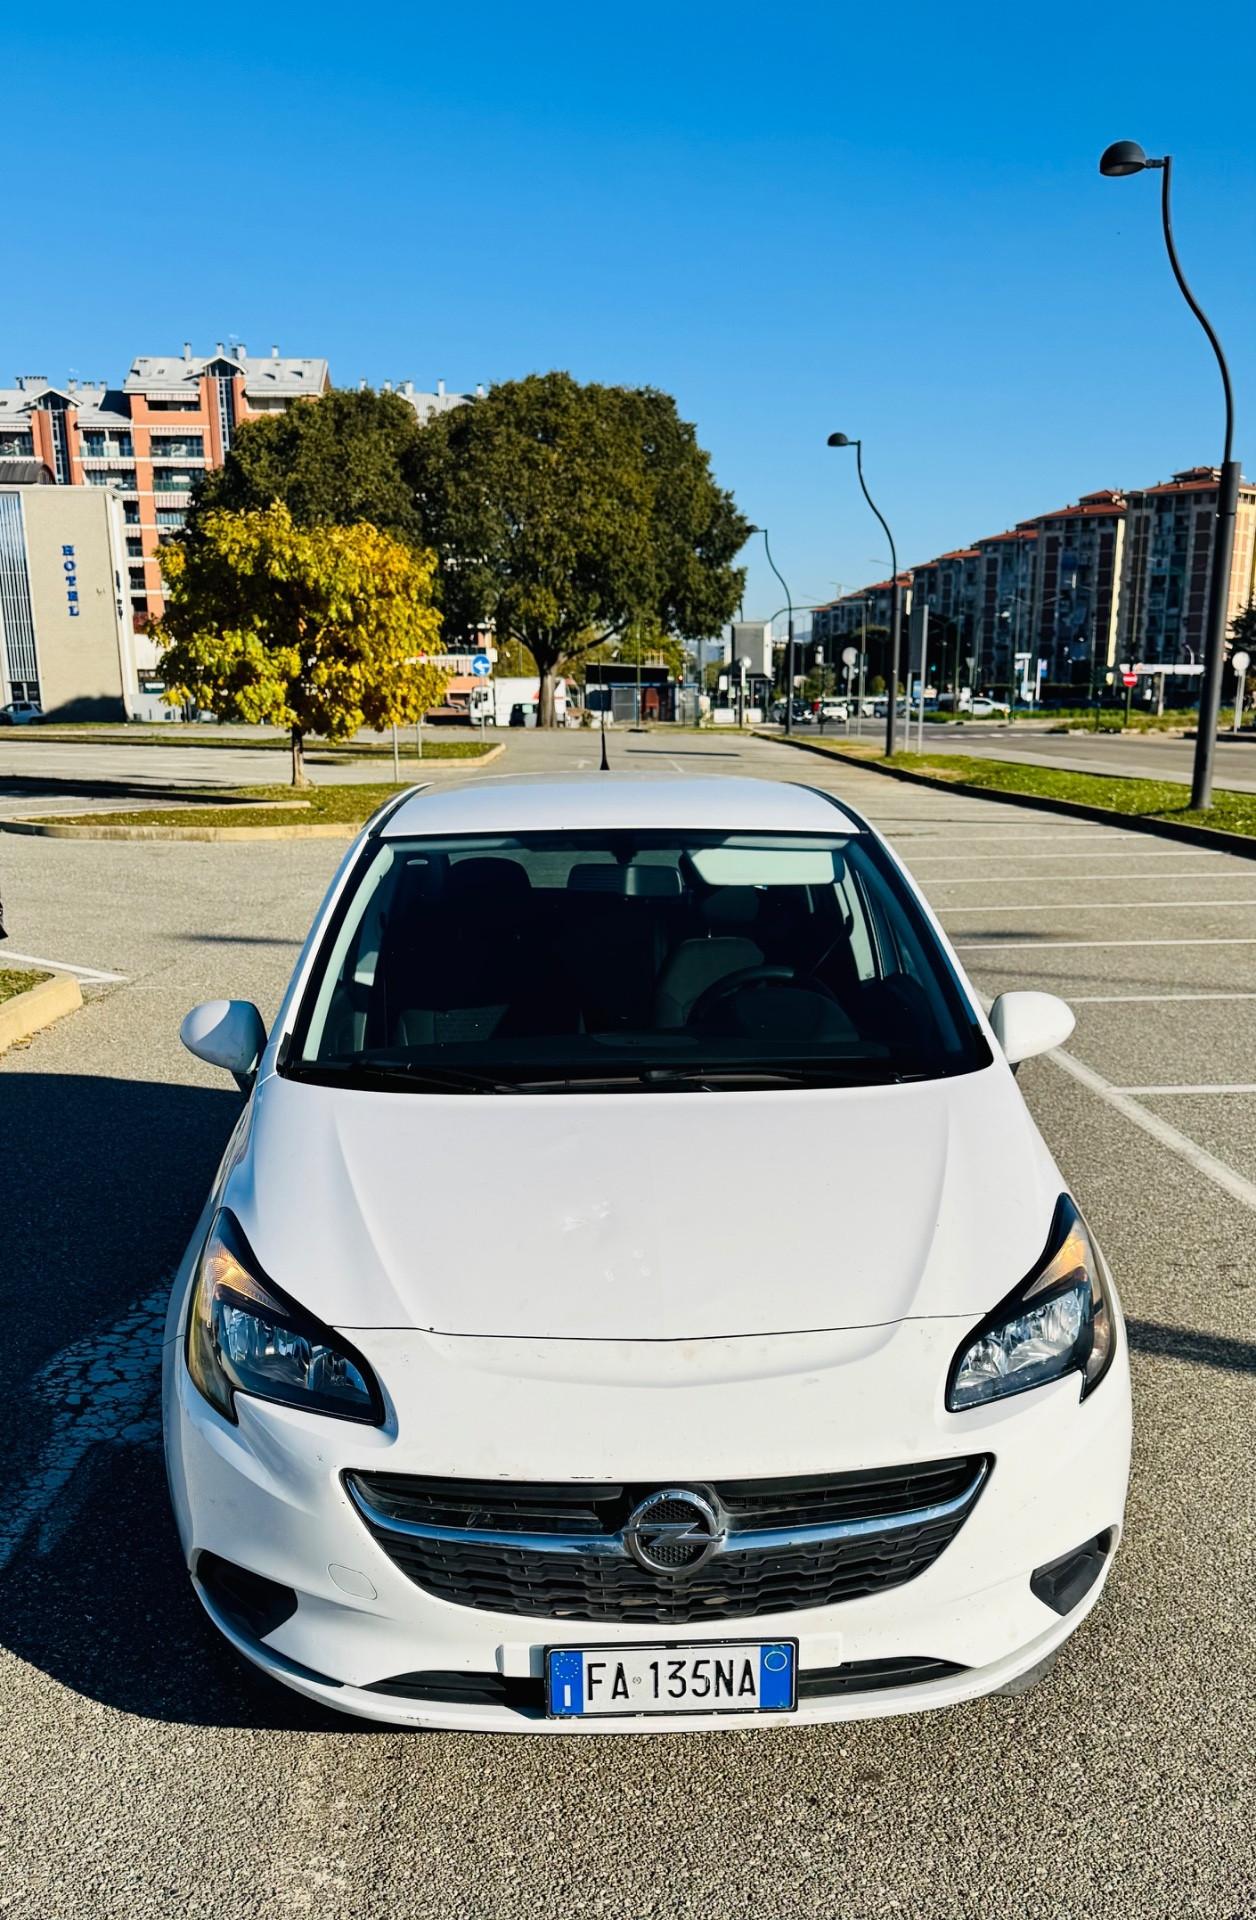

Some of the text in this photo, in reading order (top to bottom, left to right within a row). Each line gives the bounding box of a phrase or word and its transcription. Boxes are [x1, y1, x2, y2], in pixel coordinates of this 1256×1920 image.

[62, 545, 79, 616] HOTEL
[564, 1685, 571, 1706] I
[587, 1659, 756, 1700] FA 135NA
